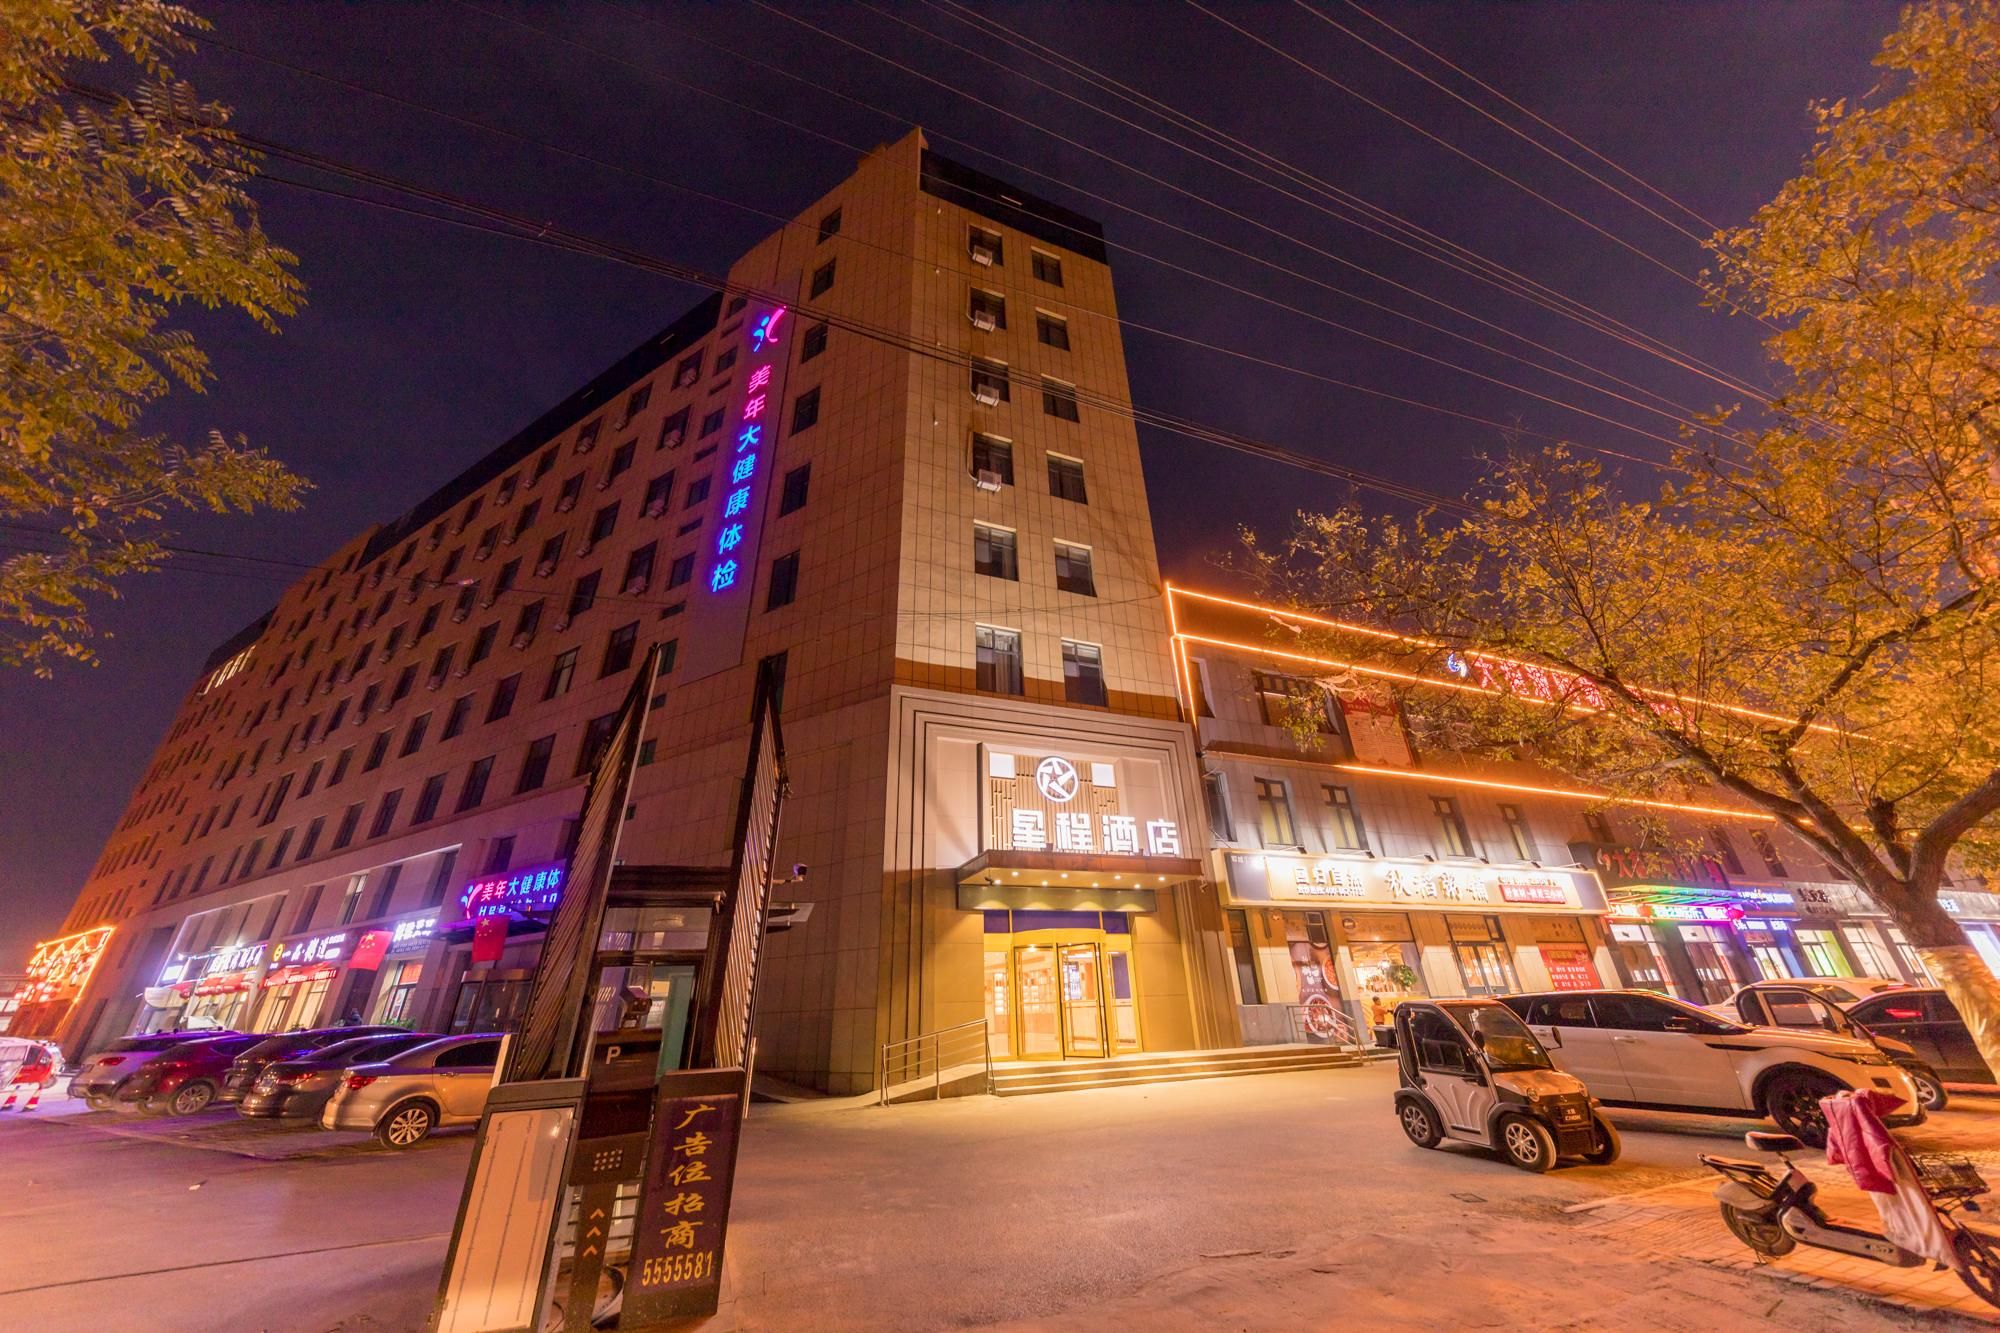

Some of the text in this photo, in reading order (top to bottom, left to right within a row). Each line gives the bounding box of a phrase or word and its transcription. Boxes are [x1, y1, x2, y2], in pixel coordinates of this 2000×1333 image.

[711, 364, 771, 593] 美年大健康体检
[1012, 808, 1180, 856] 星程酒店
[606, 1046, 621, 1065] P
[660, 1103, 716, 1249] 广告位招商
[642, 1250, 713, 1287] 5555581
